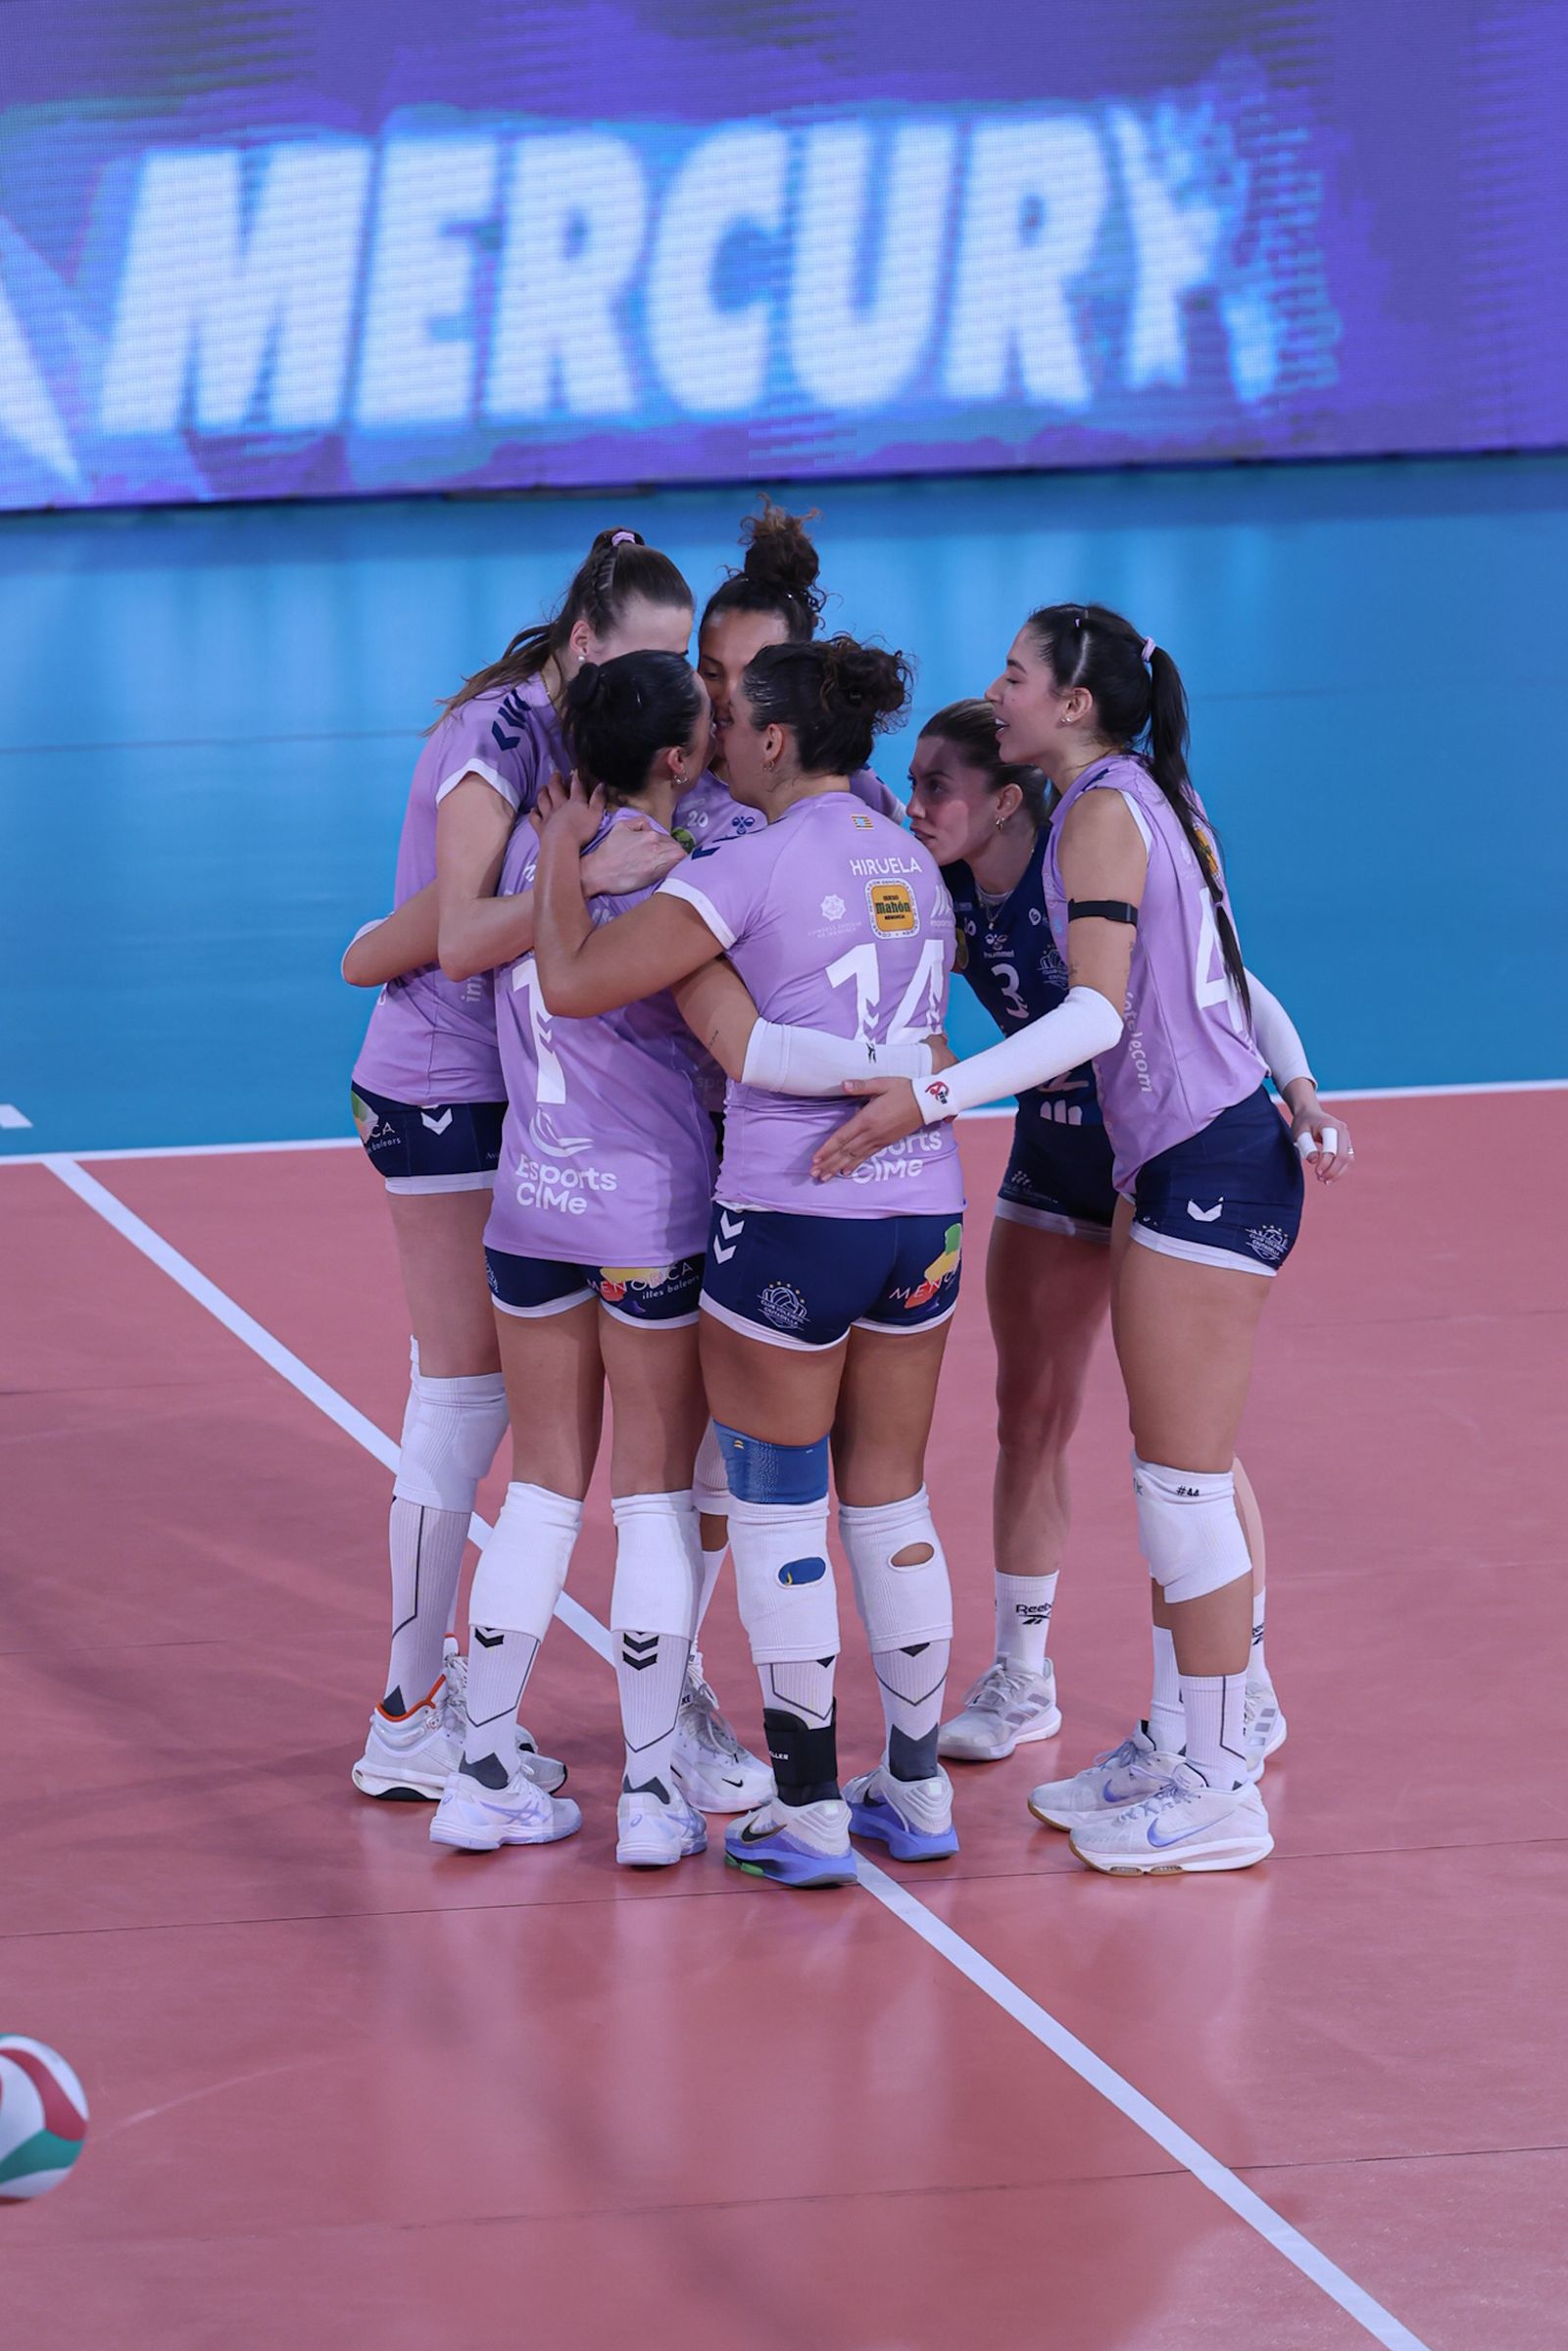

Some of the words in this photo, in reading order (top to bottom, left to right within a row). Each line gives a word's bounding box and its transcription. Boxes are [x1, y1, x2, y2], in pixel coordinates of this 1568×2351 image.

[96, 104, 1223, 433] MERCURY
[687, 810, 710, 828] 20
[850, 857, 922, 876] HIRUELA
[824, 938, 945, 1045] 14
[991, 962, 1030, 1019] 3
[515, 1153, 618, 1192] Esports
[1176, 1485, 1200, 1497] #44
